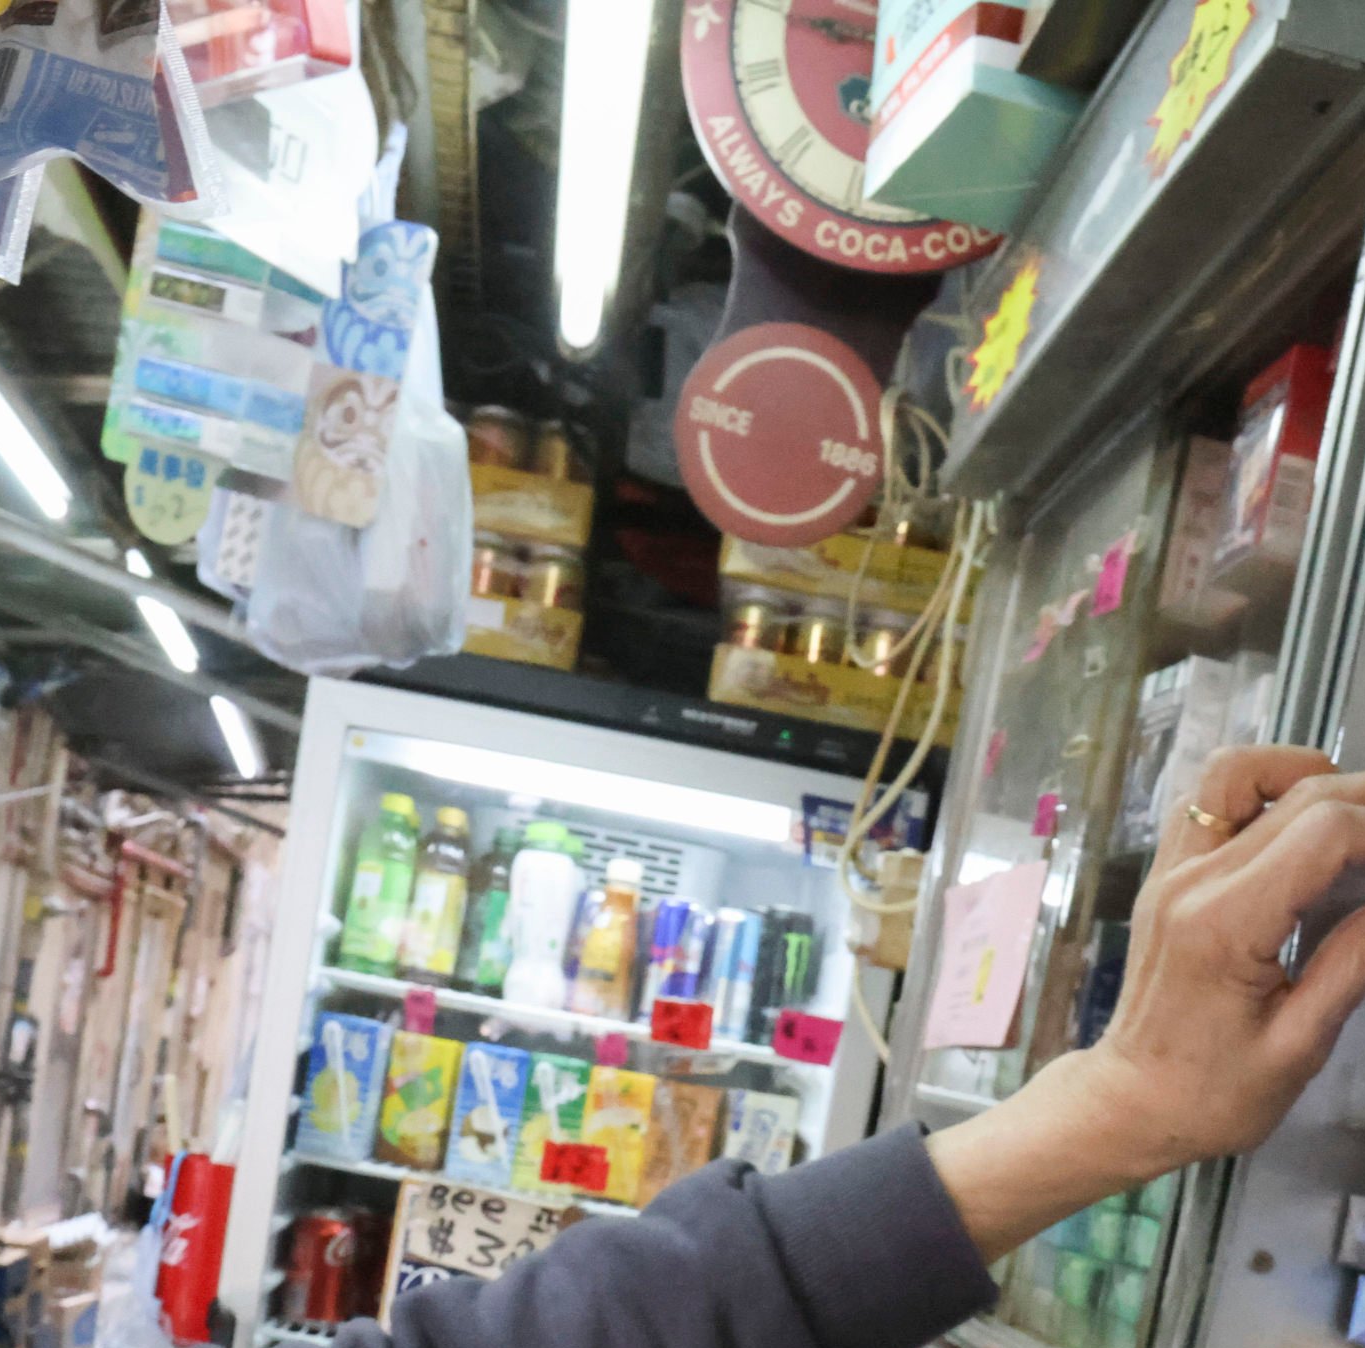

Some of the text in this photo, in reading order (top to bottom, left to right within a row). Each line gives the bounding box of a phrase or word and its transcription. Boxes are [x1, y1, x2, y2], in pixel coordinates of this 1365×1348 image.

[707, 115, 995, 263] ALWAYS COCA-COL
[689, 395, 754, 437] SINCE
